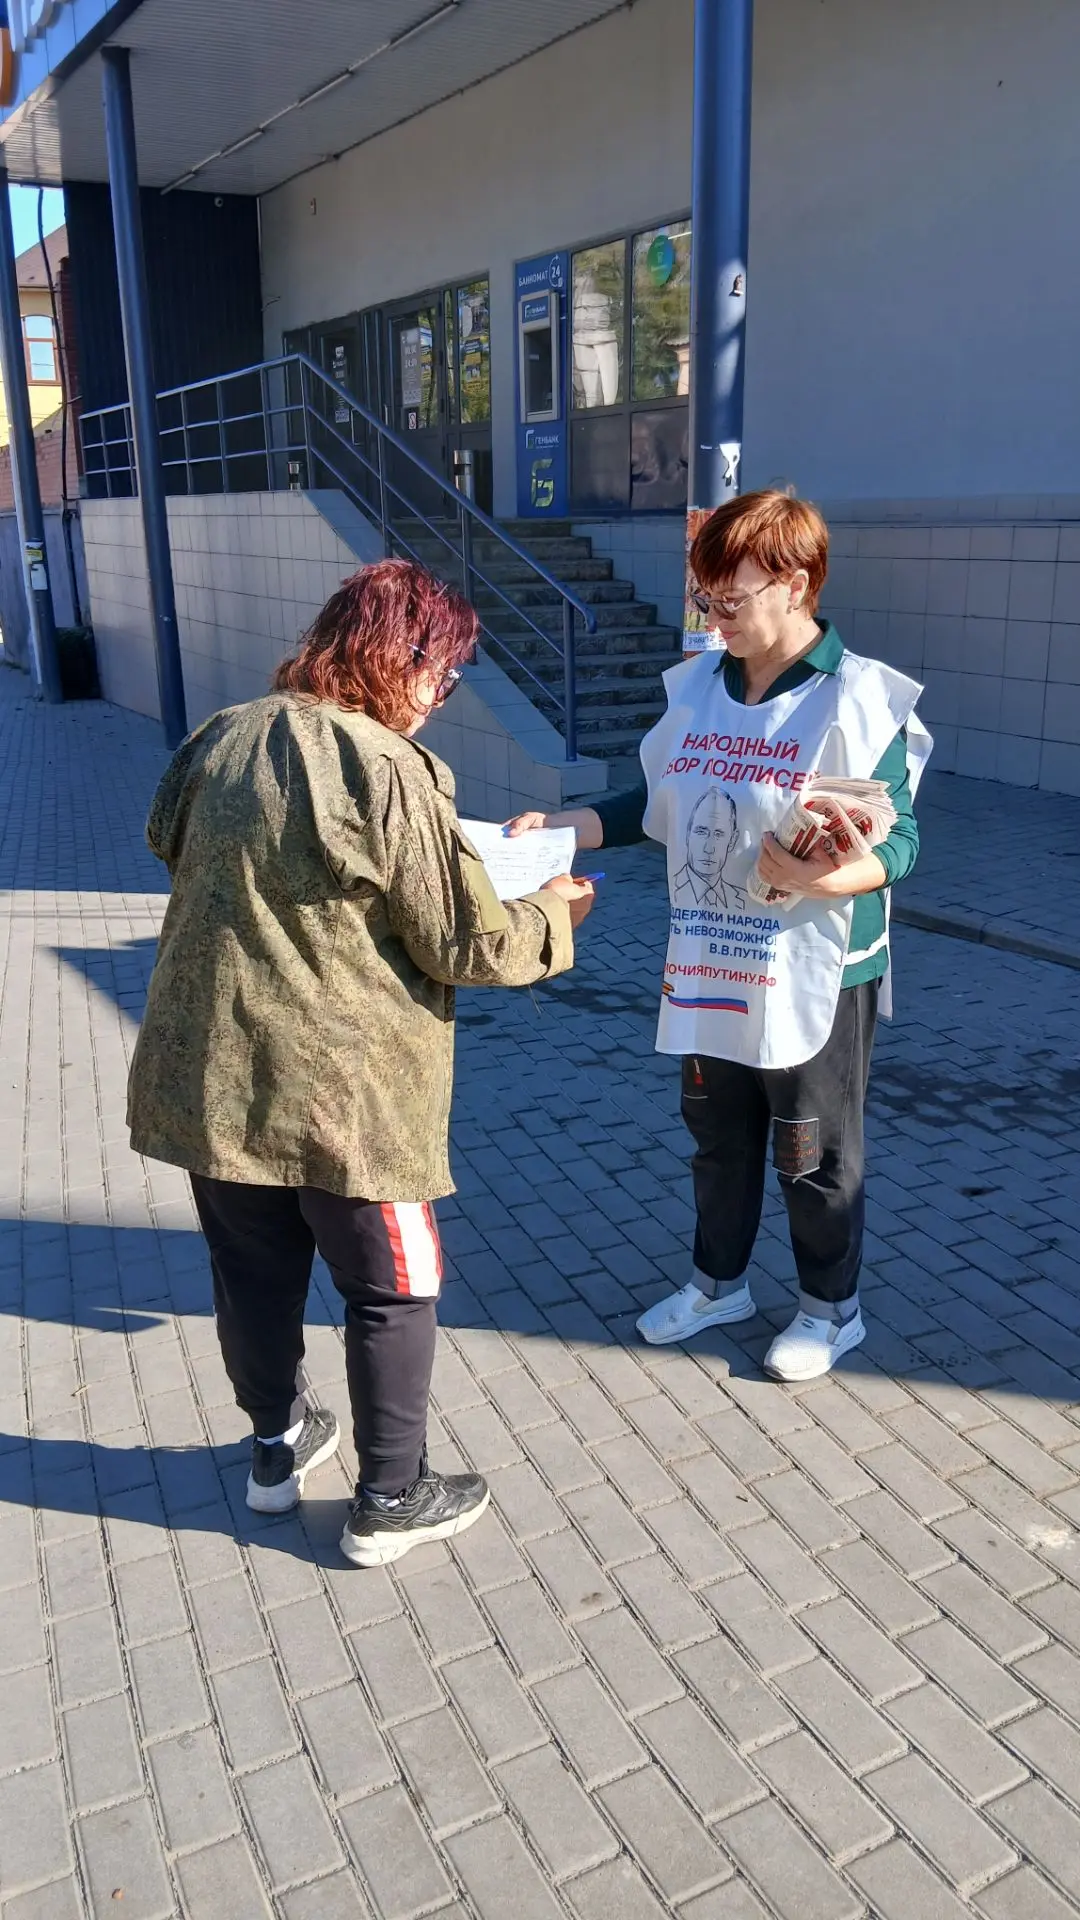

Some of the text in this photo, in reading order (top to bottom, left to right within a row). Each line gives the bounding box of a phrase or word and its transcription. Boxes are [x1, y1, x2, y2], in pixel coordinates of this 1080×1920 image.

[519, 264, 561, 287] БАНКОМАТ 24
[682, 732, 800, 762] НАРОДНЫЙ
[662, 756, 814, 791] БОР ПОДПИСЕ
[671, 907, 780, 931] ДЕРЖКИ НАРОДА
[685, 925, 777, 946] НЕВОЗМОЖНО!
[709, 943, 777, 962] В.В.ПУТИН
